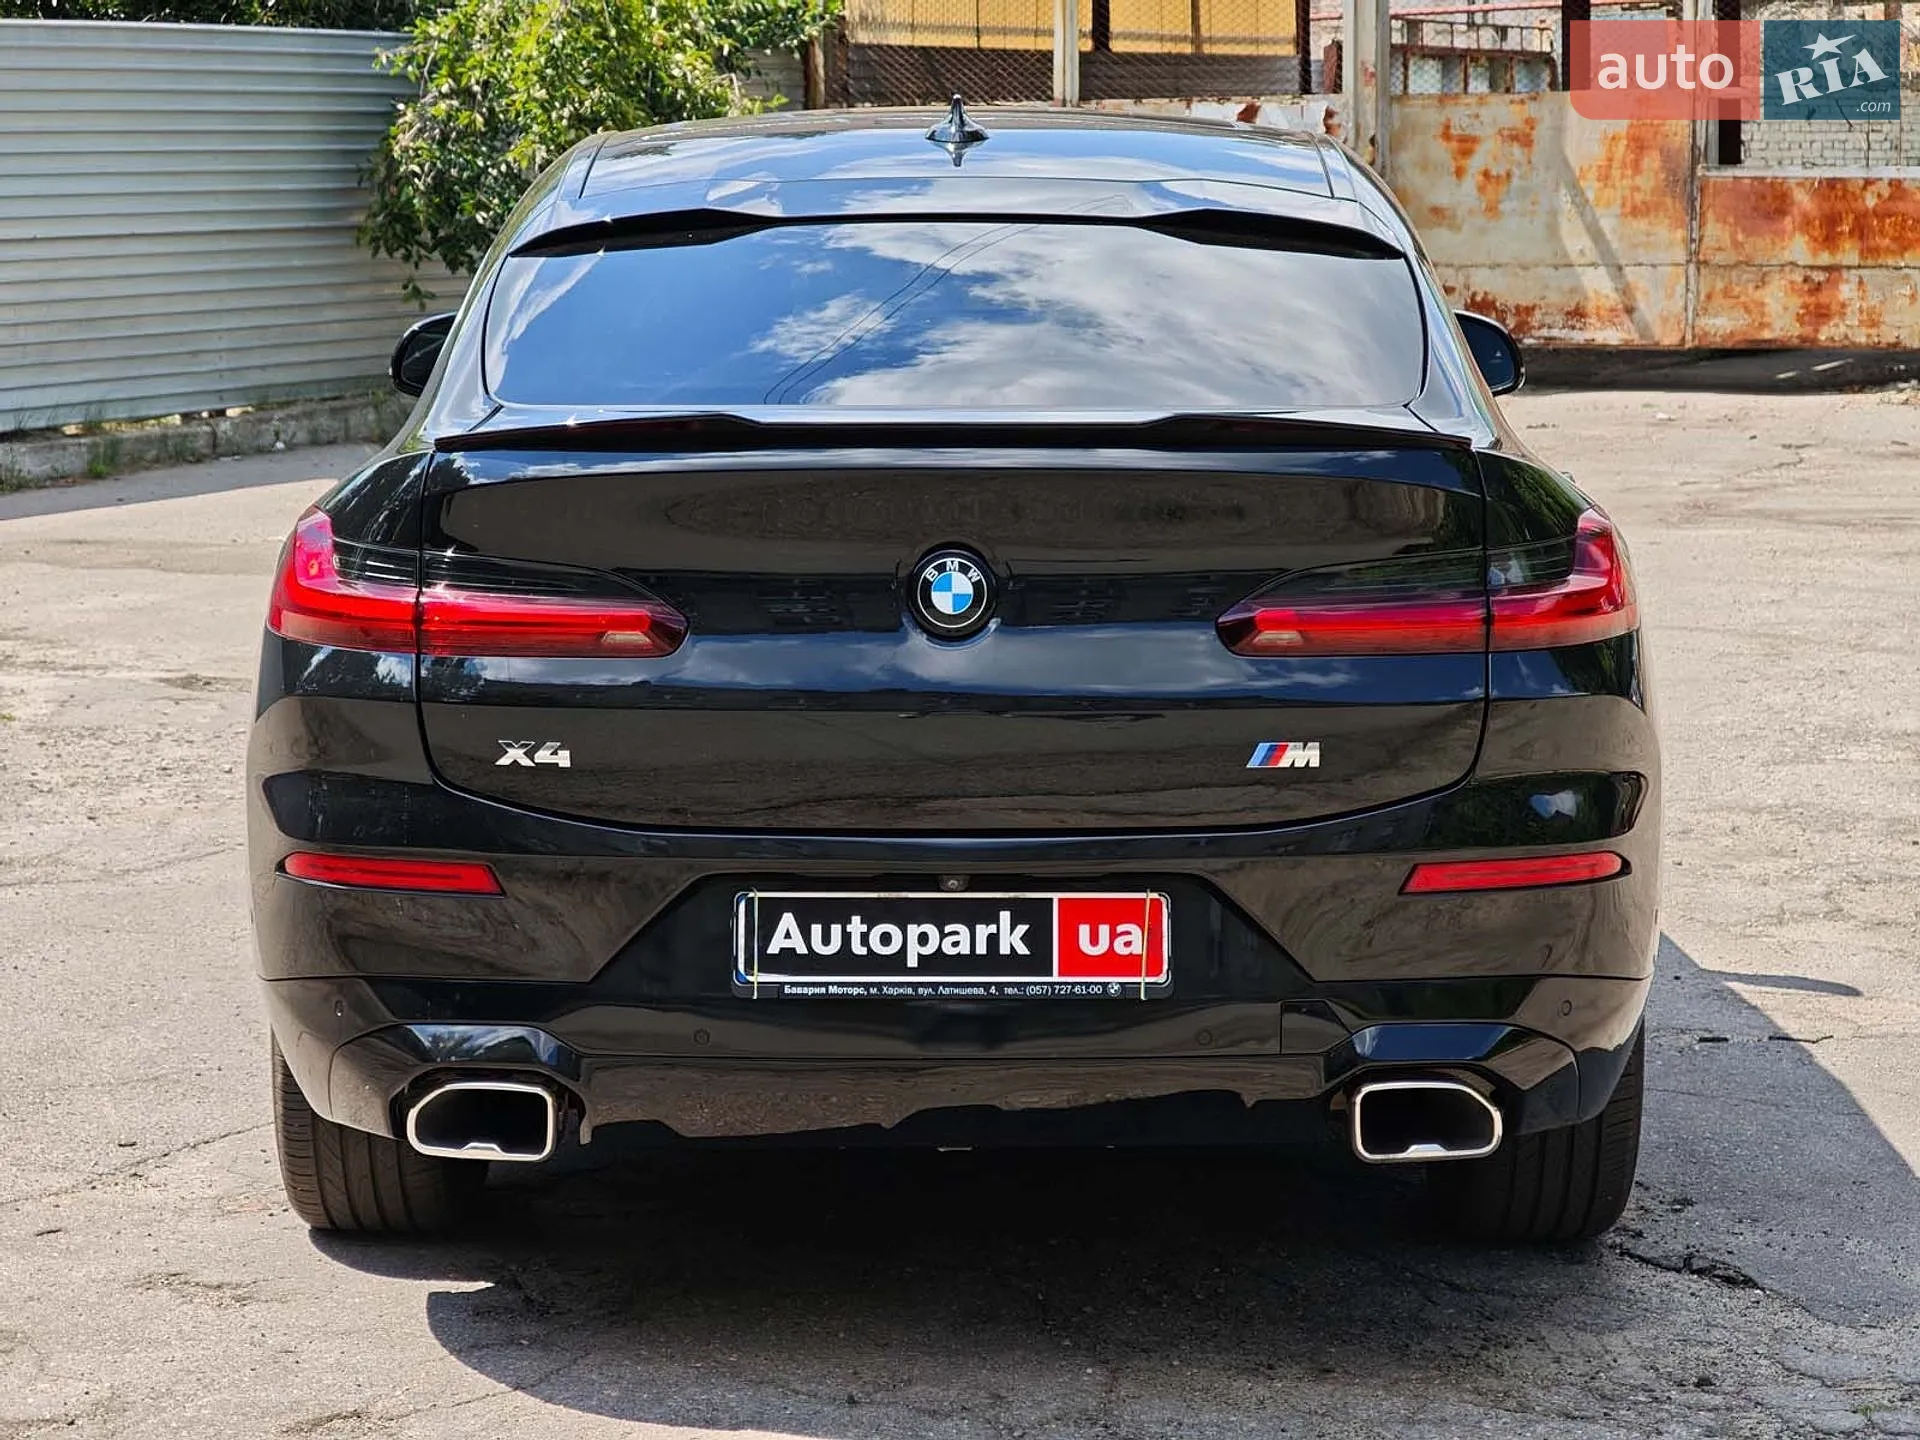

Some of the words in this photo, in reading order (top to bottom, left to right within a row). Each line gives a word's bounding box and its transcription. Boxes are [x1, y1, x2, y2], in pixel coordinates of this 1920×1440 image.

[925, 560, 981, 582] BMW
[495, 740, 571, 768] X4
[1277, 742, 1320, 767] M
[766, 911, 1031, 968] Autopark
[1078, 923, 1143, 956] ua
[828, 985, 867, 996] Моторс,
[1026, 985, 1052, 996] (057)
[1054, 985, 1103, 995] 727-61-00
